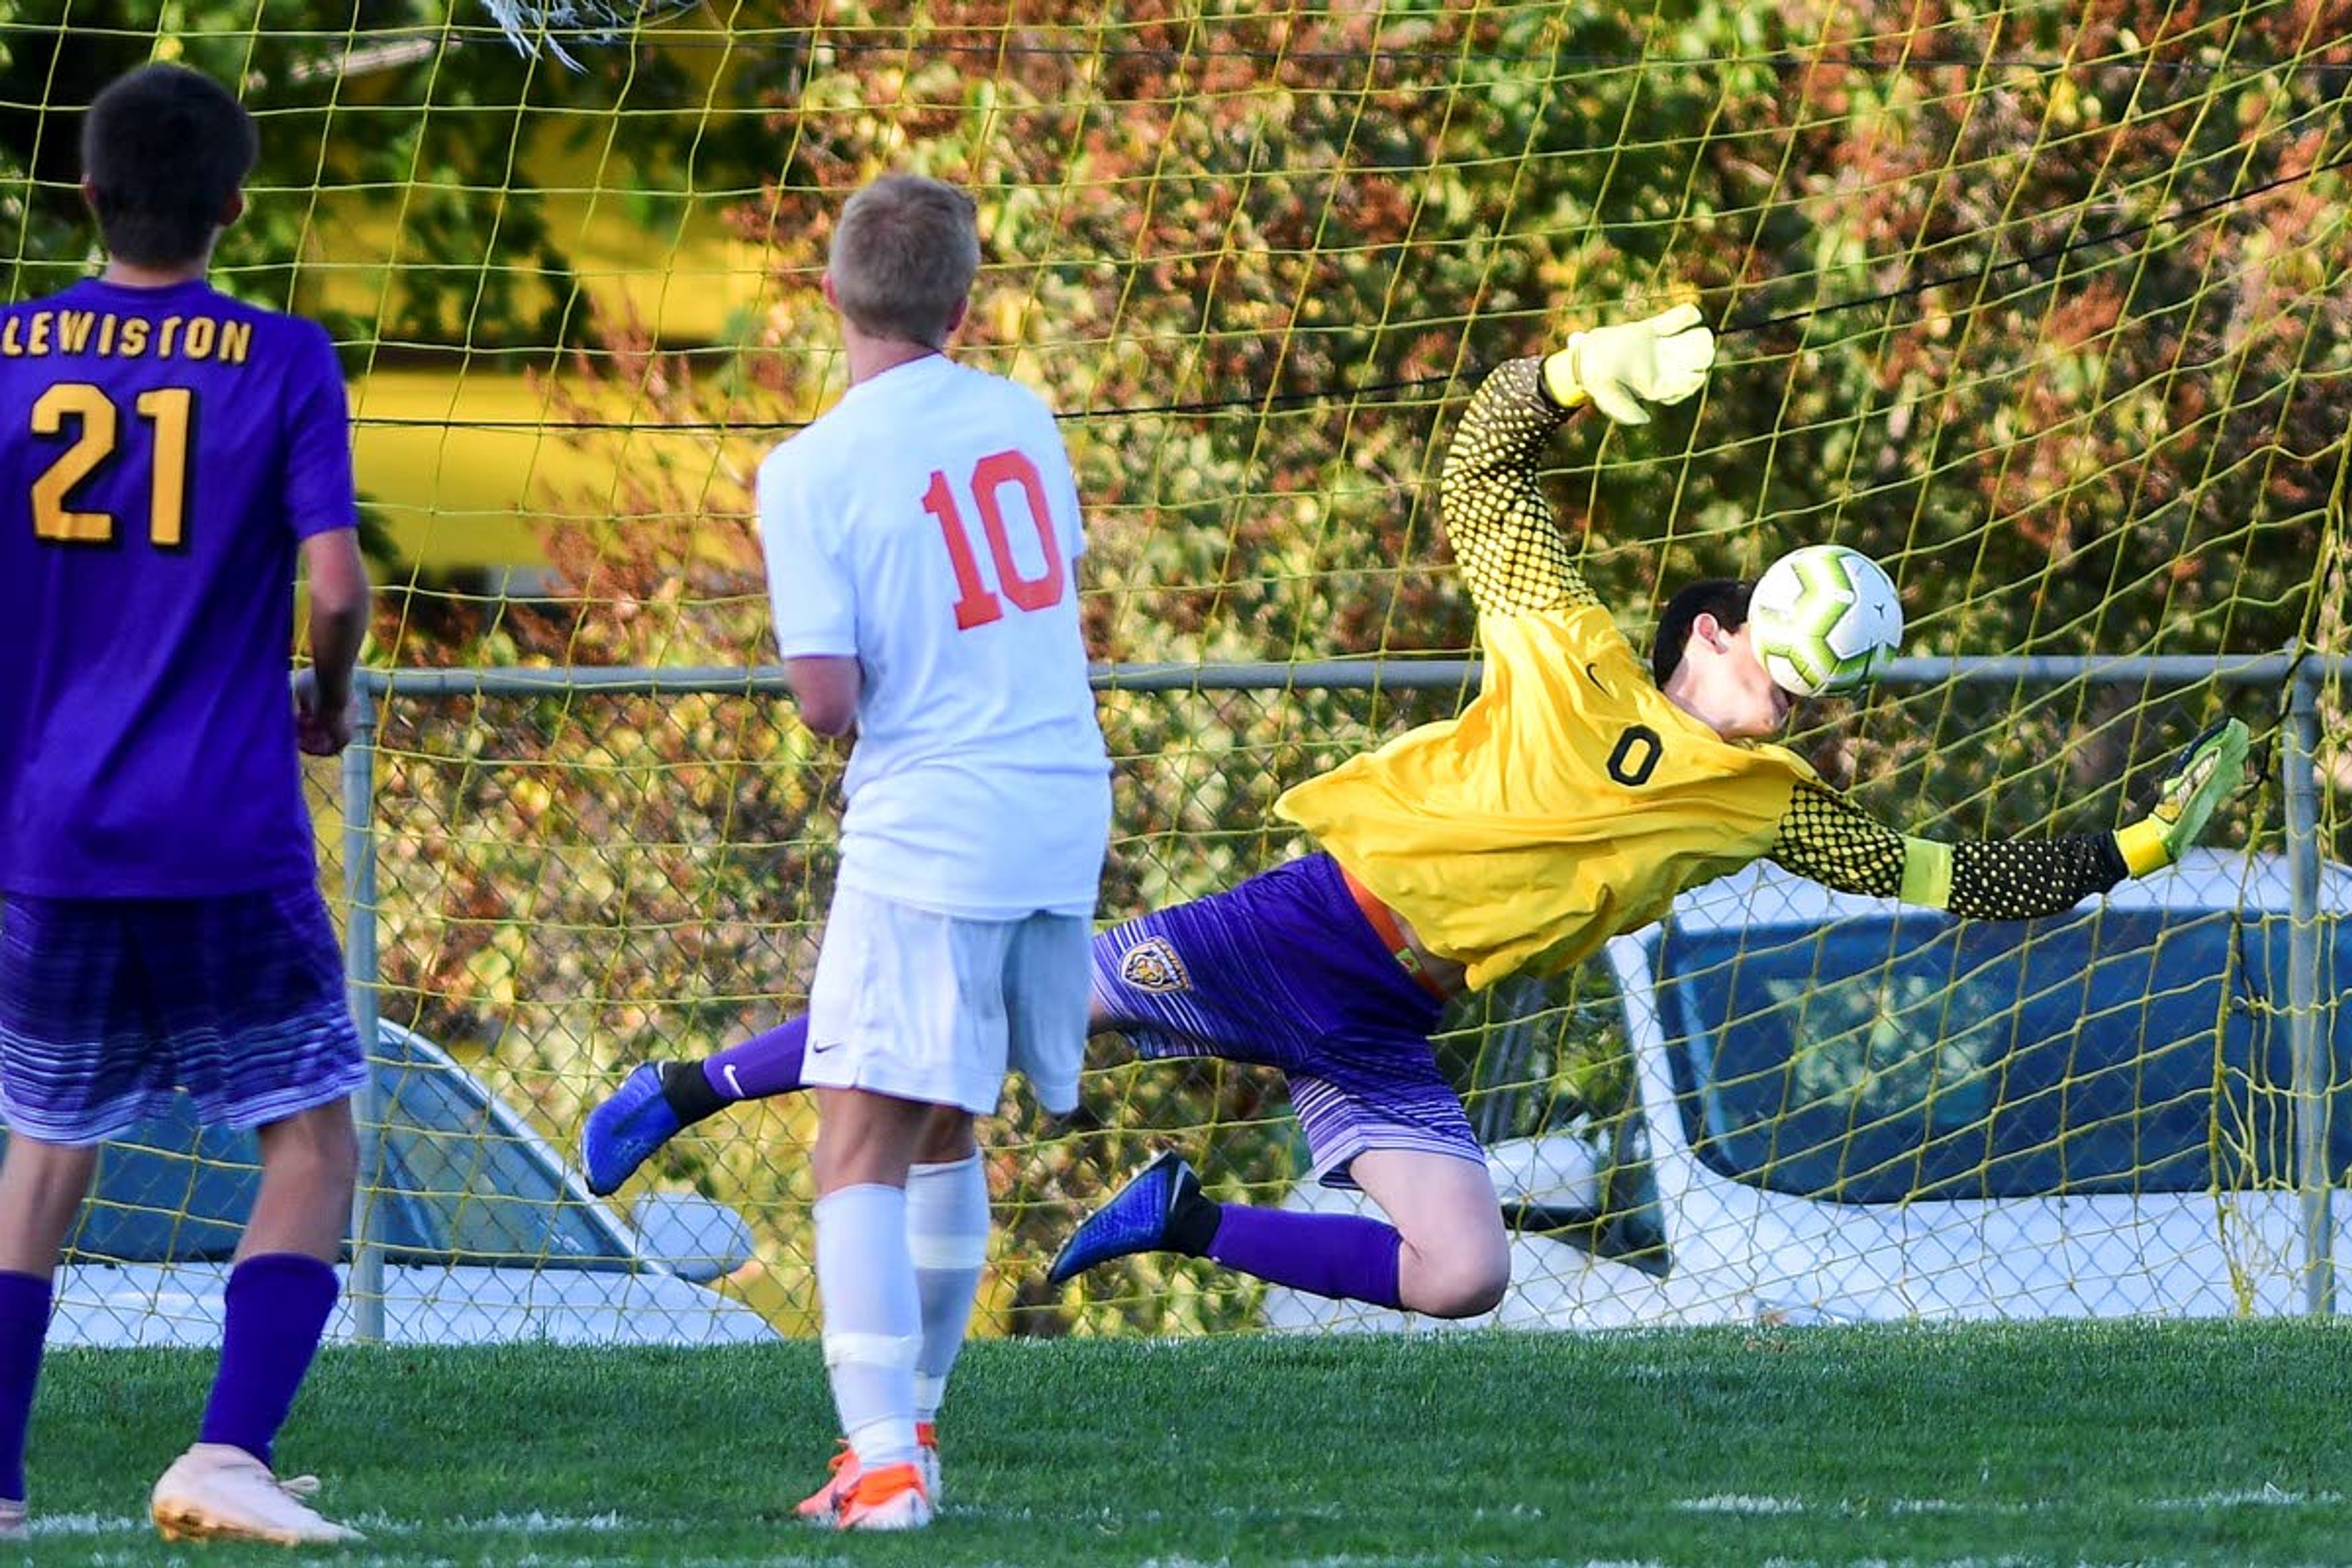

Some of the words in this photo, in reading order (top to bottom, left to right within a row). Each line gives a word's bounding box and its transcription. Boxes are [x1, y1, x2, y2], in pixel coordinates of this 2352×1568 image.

[1, 310, 252, 364] LEWISTON
[31, 383, 192, 546] 21
[922, 449, 1065, 630] 10
[1606, 724, 1664, 787] 0
